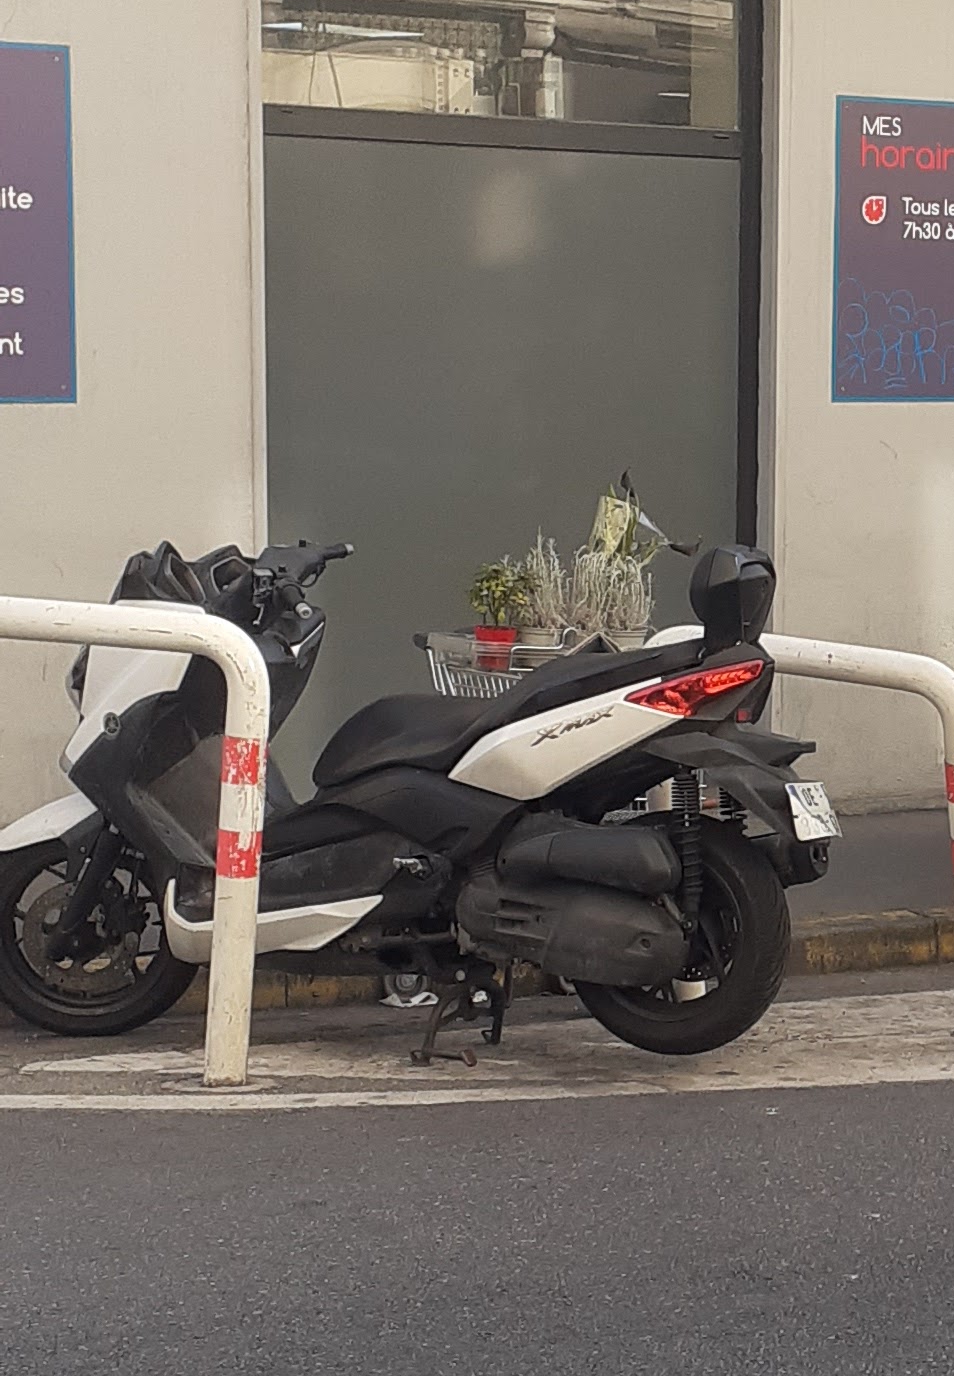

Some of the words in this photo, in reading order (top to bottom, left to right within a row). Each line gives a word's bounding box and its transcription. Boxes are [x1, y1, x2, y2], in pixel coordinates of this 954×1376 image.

[862, 115, 902, 136] MES
[0, 186, 33, 209] ite
[901, 197, 940, 215] Tous
[903, 222, 941, 240] 7h30
